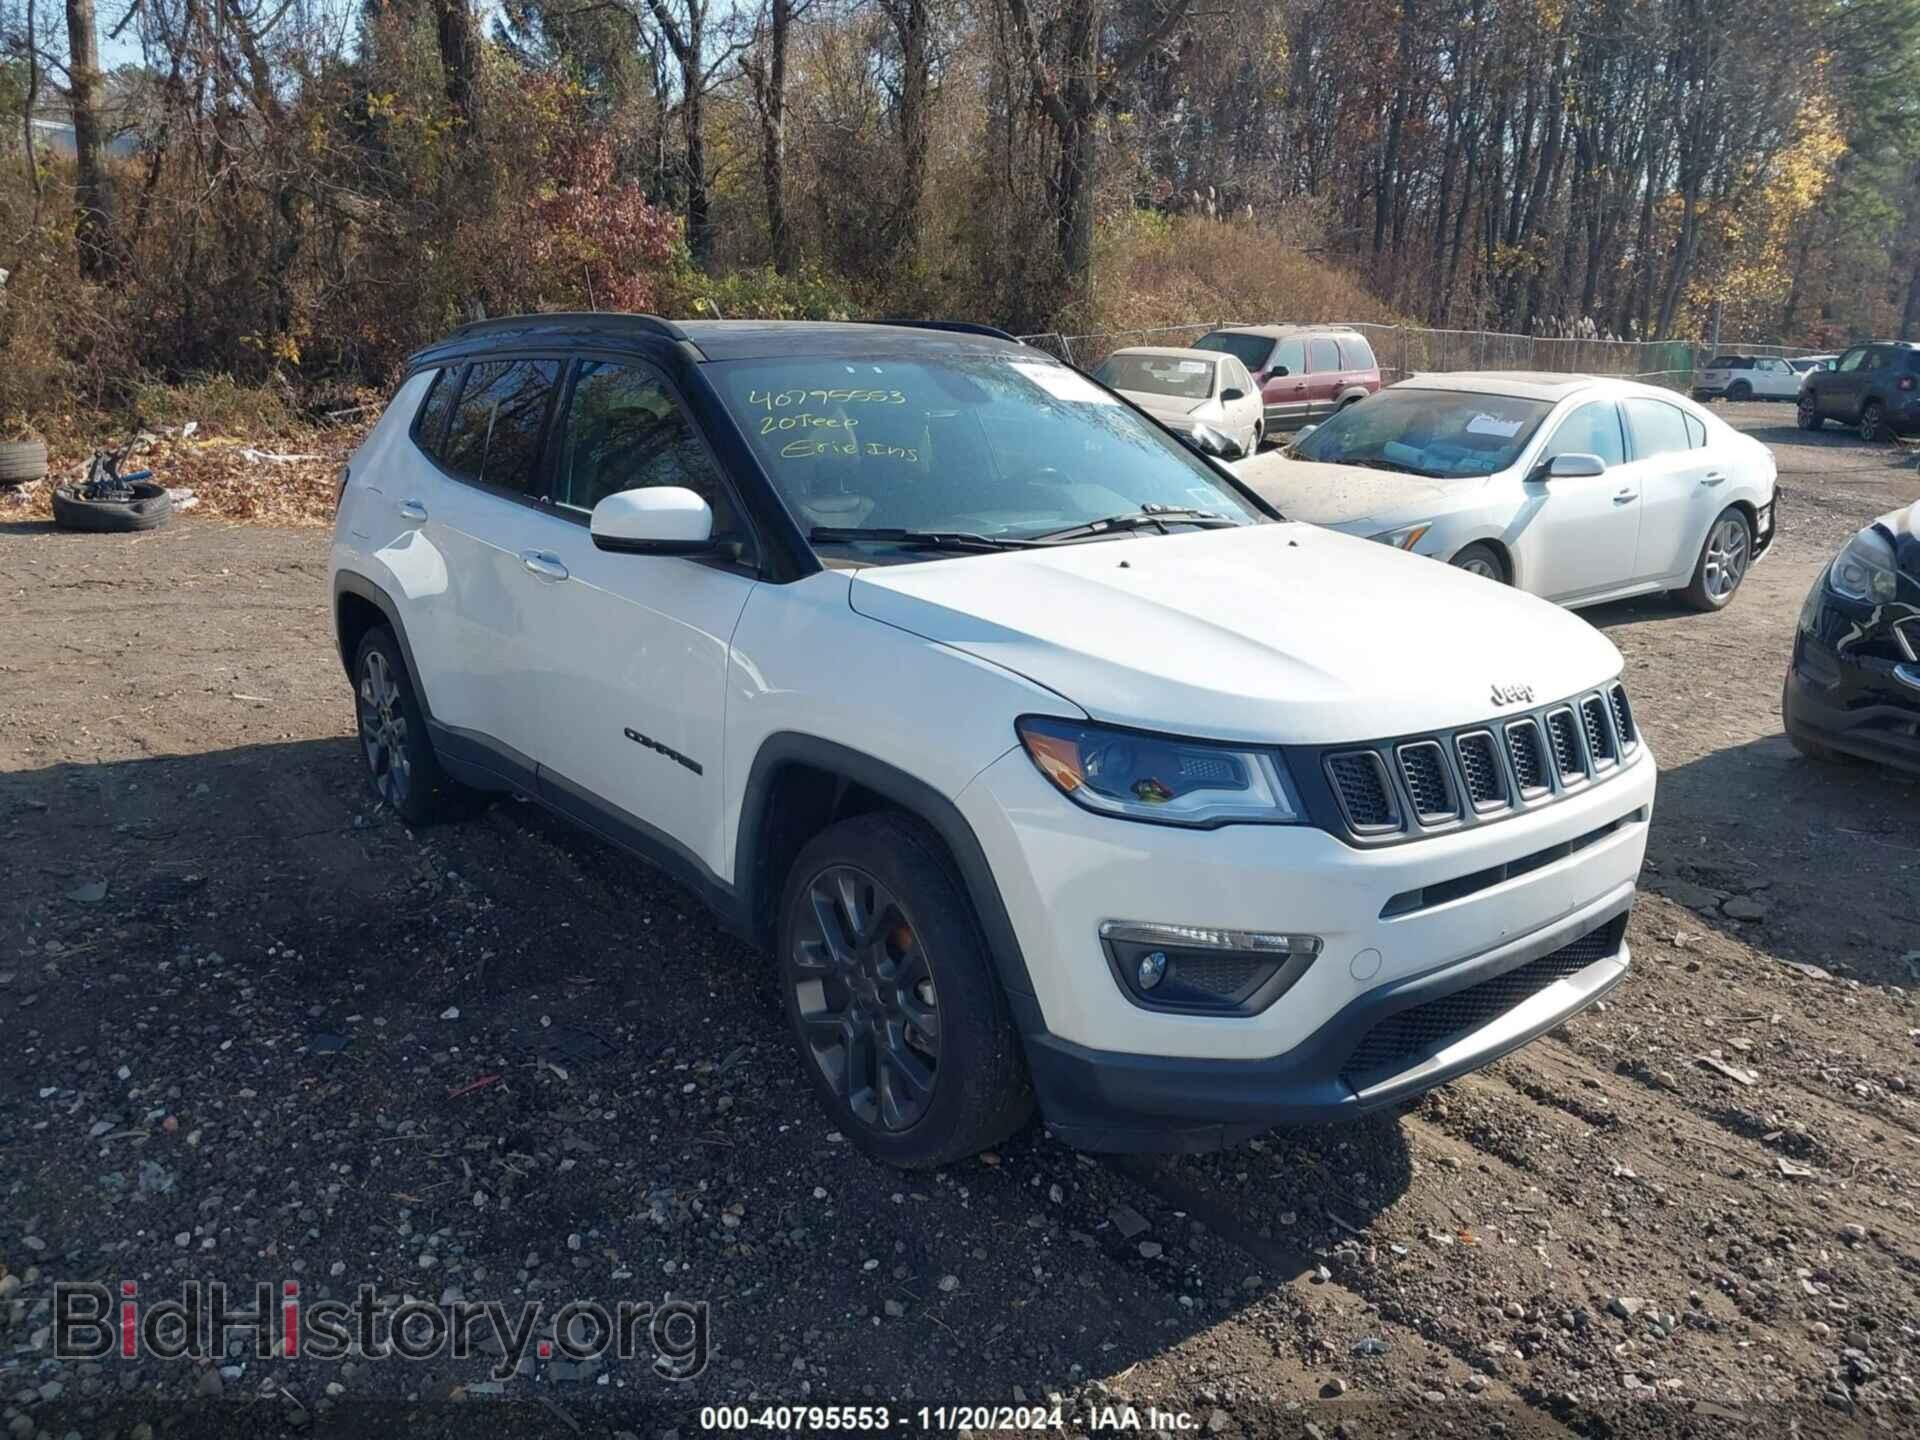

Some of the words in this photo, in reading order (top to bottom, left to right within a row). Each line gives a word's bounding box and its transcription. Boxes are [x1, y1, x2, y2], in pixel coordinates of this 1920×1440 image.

[750, 389, 906, 410] 40795553
[780, 440, 857, 458] Erie
[866, 443, 918, 462] Ins
[1490, 684, 1534, 706] Jeep
